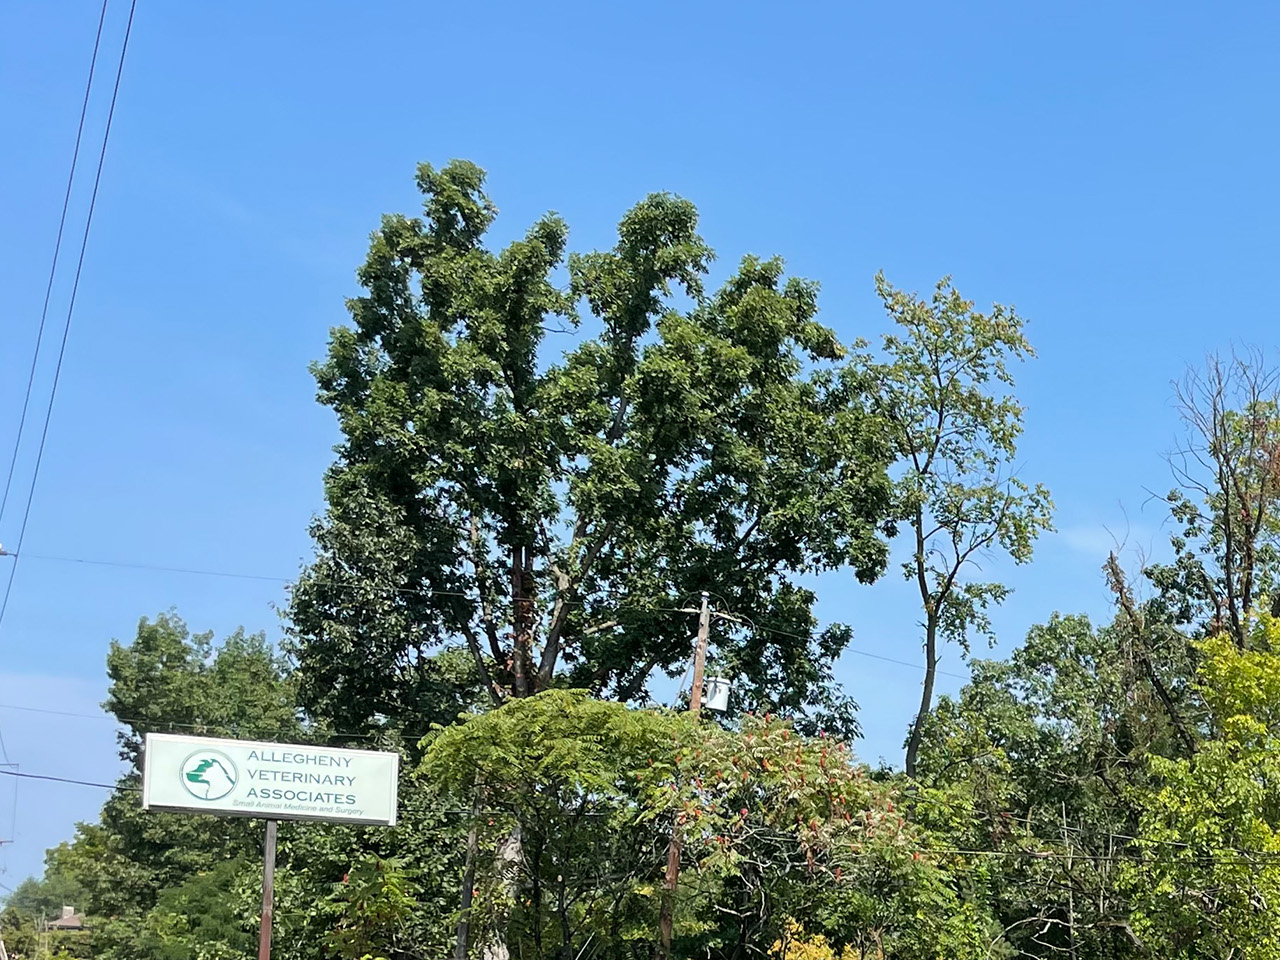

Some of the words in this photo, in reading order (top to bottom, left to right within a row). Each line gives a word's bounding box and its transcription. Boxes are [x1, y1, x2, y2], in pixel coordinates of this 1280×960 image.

[247, 750, 353, 768] ALLEGHENY
[247, 769, 357, 787] VETERINARY
[246, 787, 357, 805] ASSOCIATES
[232, 799, 255, 808] Small
[255, 801, 283, 809] Animal
[283, 803, 318, 812] Medicine
[318, 805, 334, 813] and
[334, 806, 365, 816] Surgery
